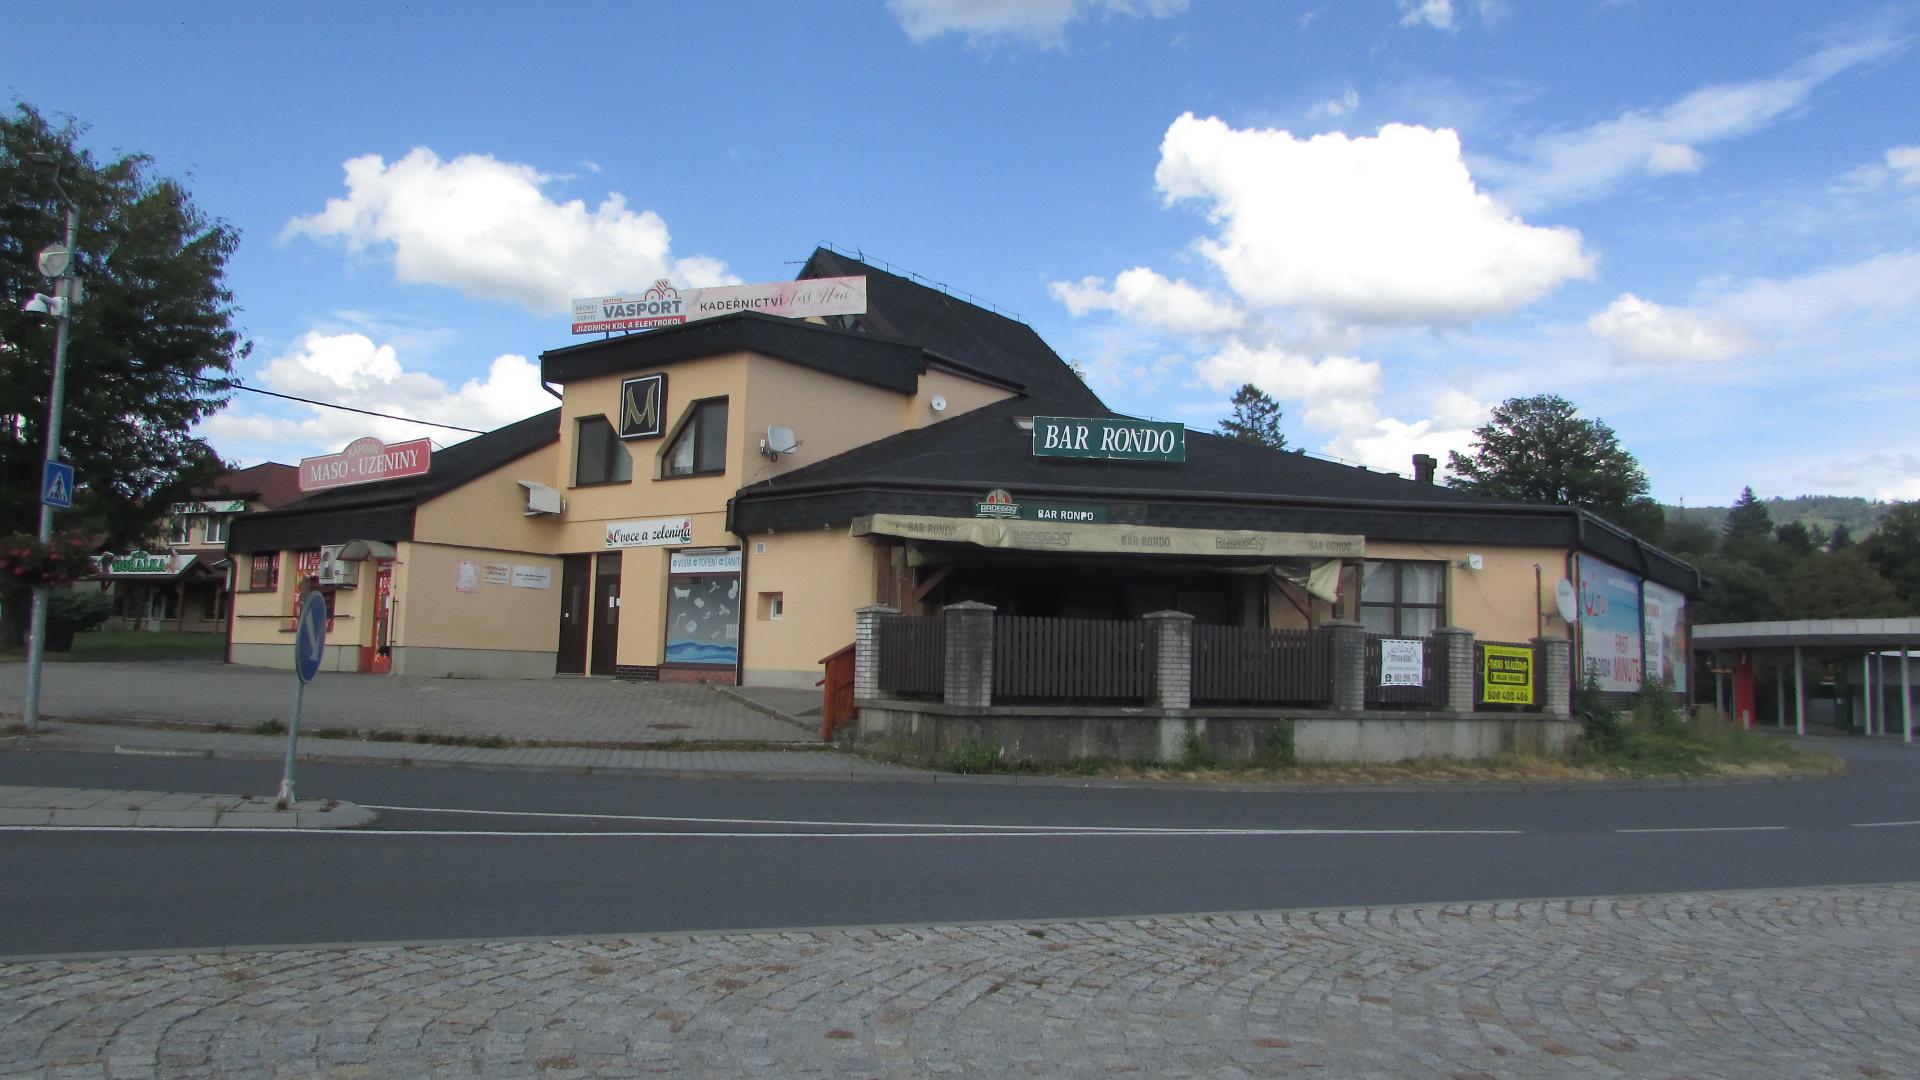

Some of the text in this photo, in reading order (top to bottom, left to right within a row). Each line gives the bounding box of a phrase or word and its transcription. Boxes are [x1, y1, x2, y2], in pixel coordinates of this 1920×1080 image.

[603, 300, 682, 319] VASPORT
[700, 294, 783, 312] KADEŘNICTVÍ
[612, 321, 626, 330] KOL
[627, 320, 634, 329] A
[634, 317, 682, 328] ELEKTROKOL
[1044, 424, 1175, 454] BAR RONDO
[310, 460, 348, 482] MASO
[359, 448, 419, 474] UZENINY
[980, 504, 1019, 514] RADEGAST
[1038, 509, 1057, 519] BAR
[614, 525, 690, 543] Ovoce a zelenina
[908, 521, 957, 536] BAR RONDO
[1013, 530, 1073, 546] RADEGAST
[1121, 535, 1170, 547] BAR RONDO
[1309, 540, 1324, 550] BAR
